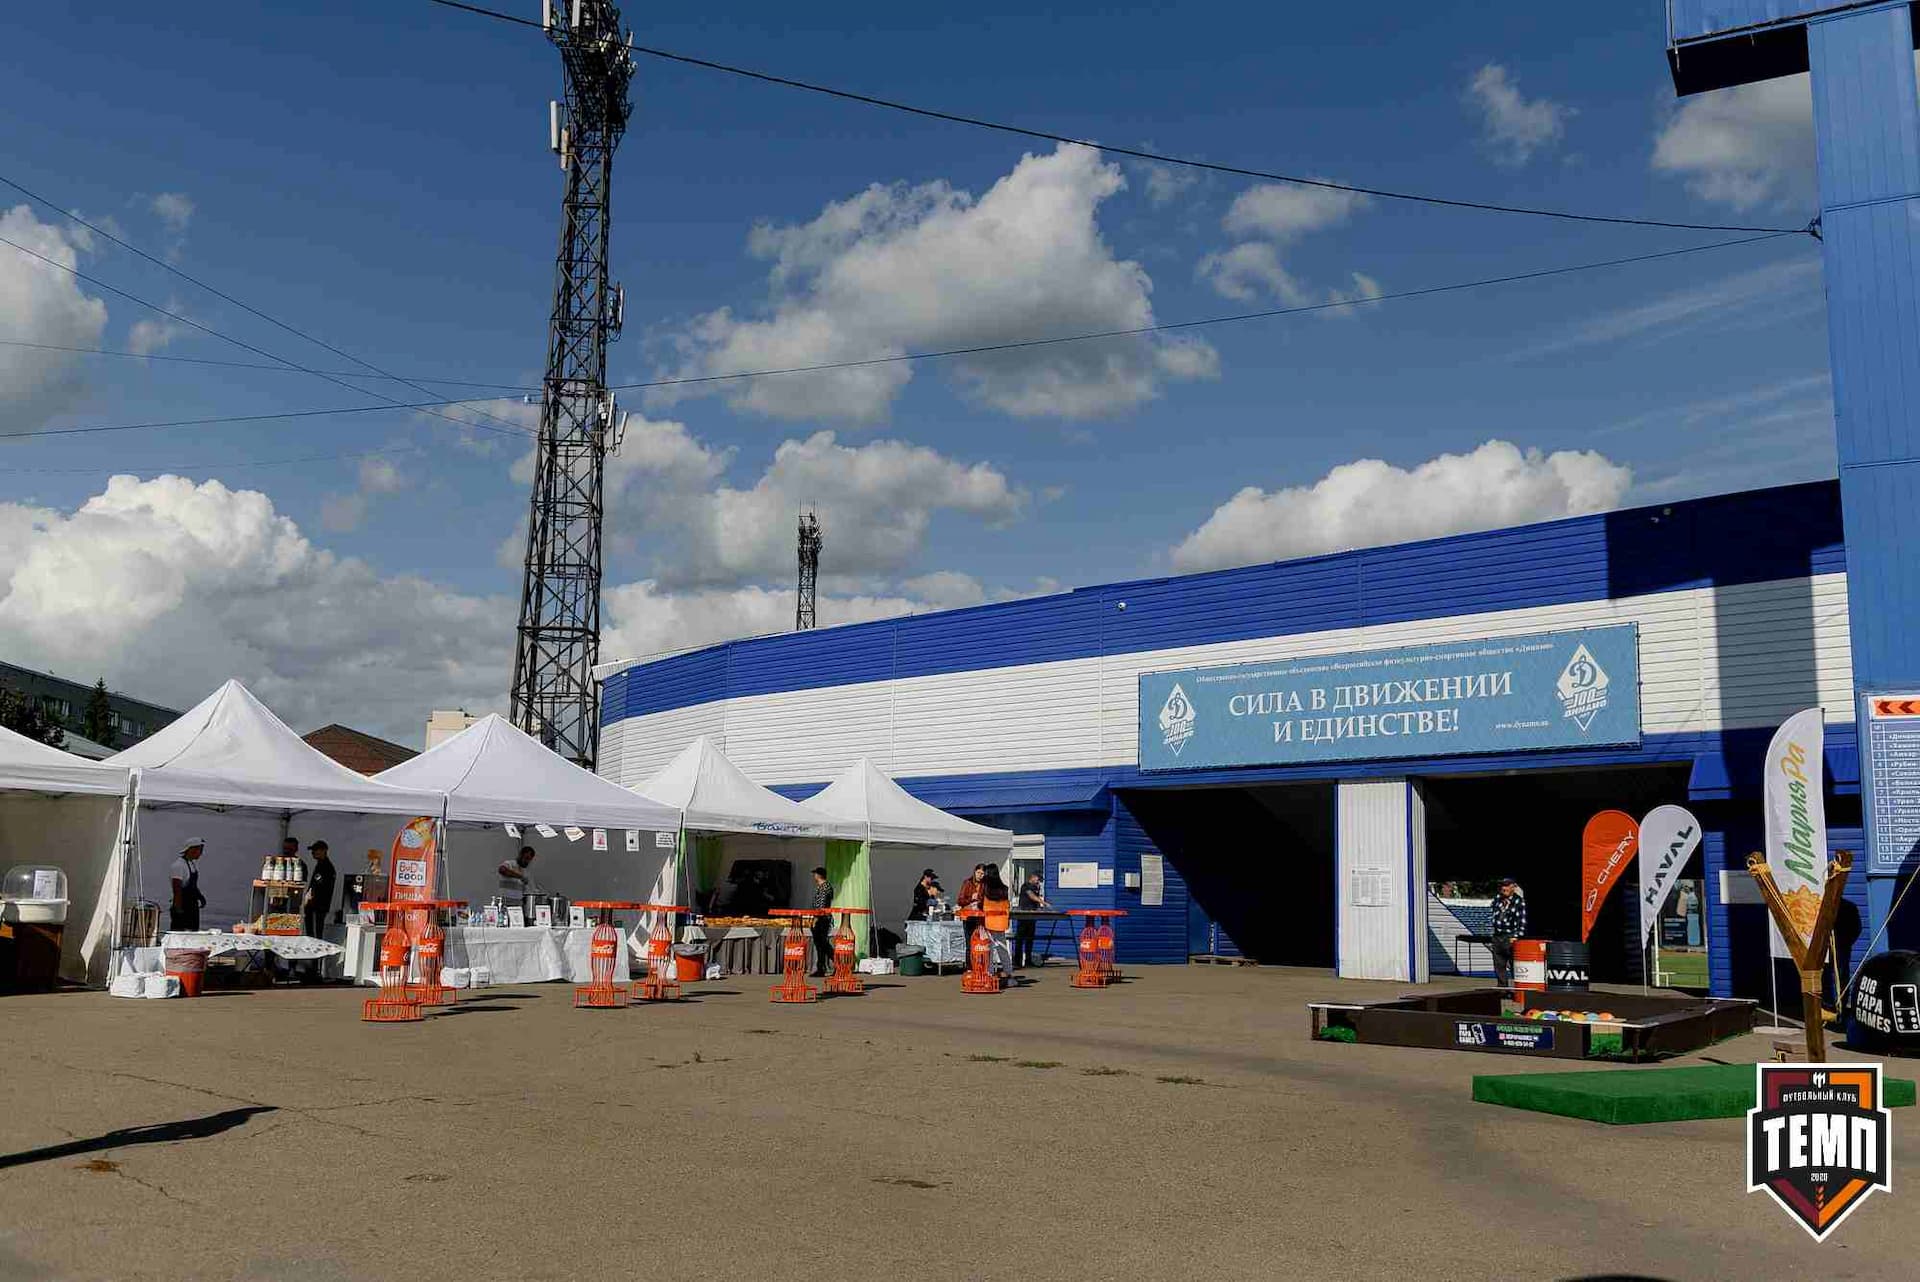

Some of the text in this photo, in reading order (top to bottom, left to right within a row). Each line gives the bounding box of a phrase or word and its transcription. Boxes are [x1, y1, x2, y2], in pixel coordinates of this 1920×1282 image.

[1229, 671, 1513, 716] СИЛА В ДВИЖЕНИИ
[1273, 708, 1459, 745] И ЕДИНСТВЕ!
[1598, 830, 1634, 884] CHERY
[1645, 825, 1694, 905] HAVAL
[1857, 991, 1882, 1015] PAPA
[1860, 975, 1877, 995] BIG
[1856, 1007, 1891, 1033] GAMES
